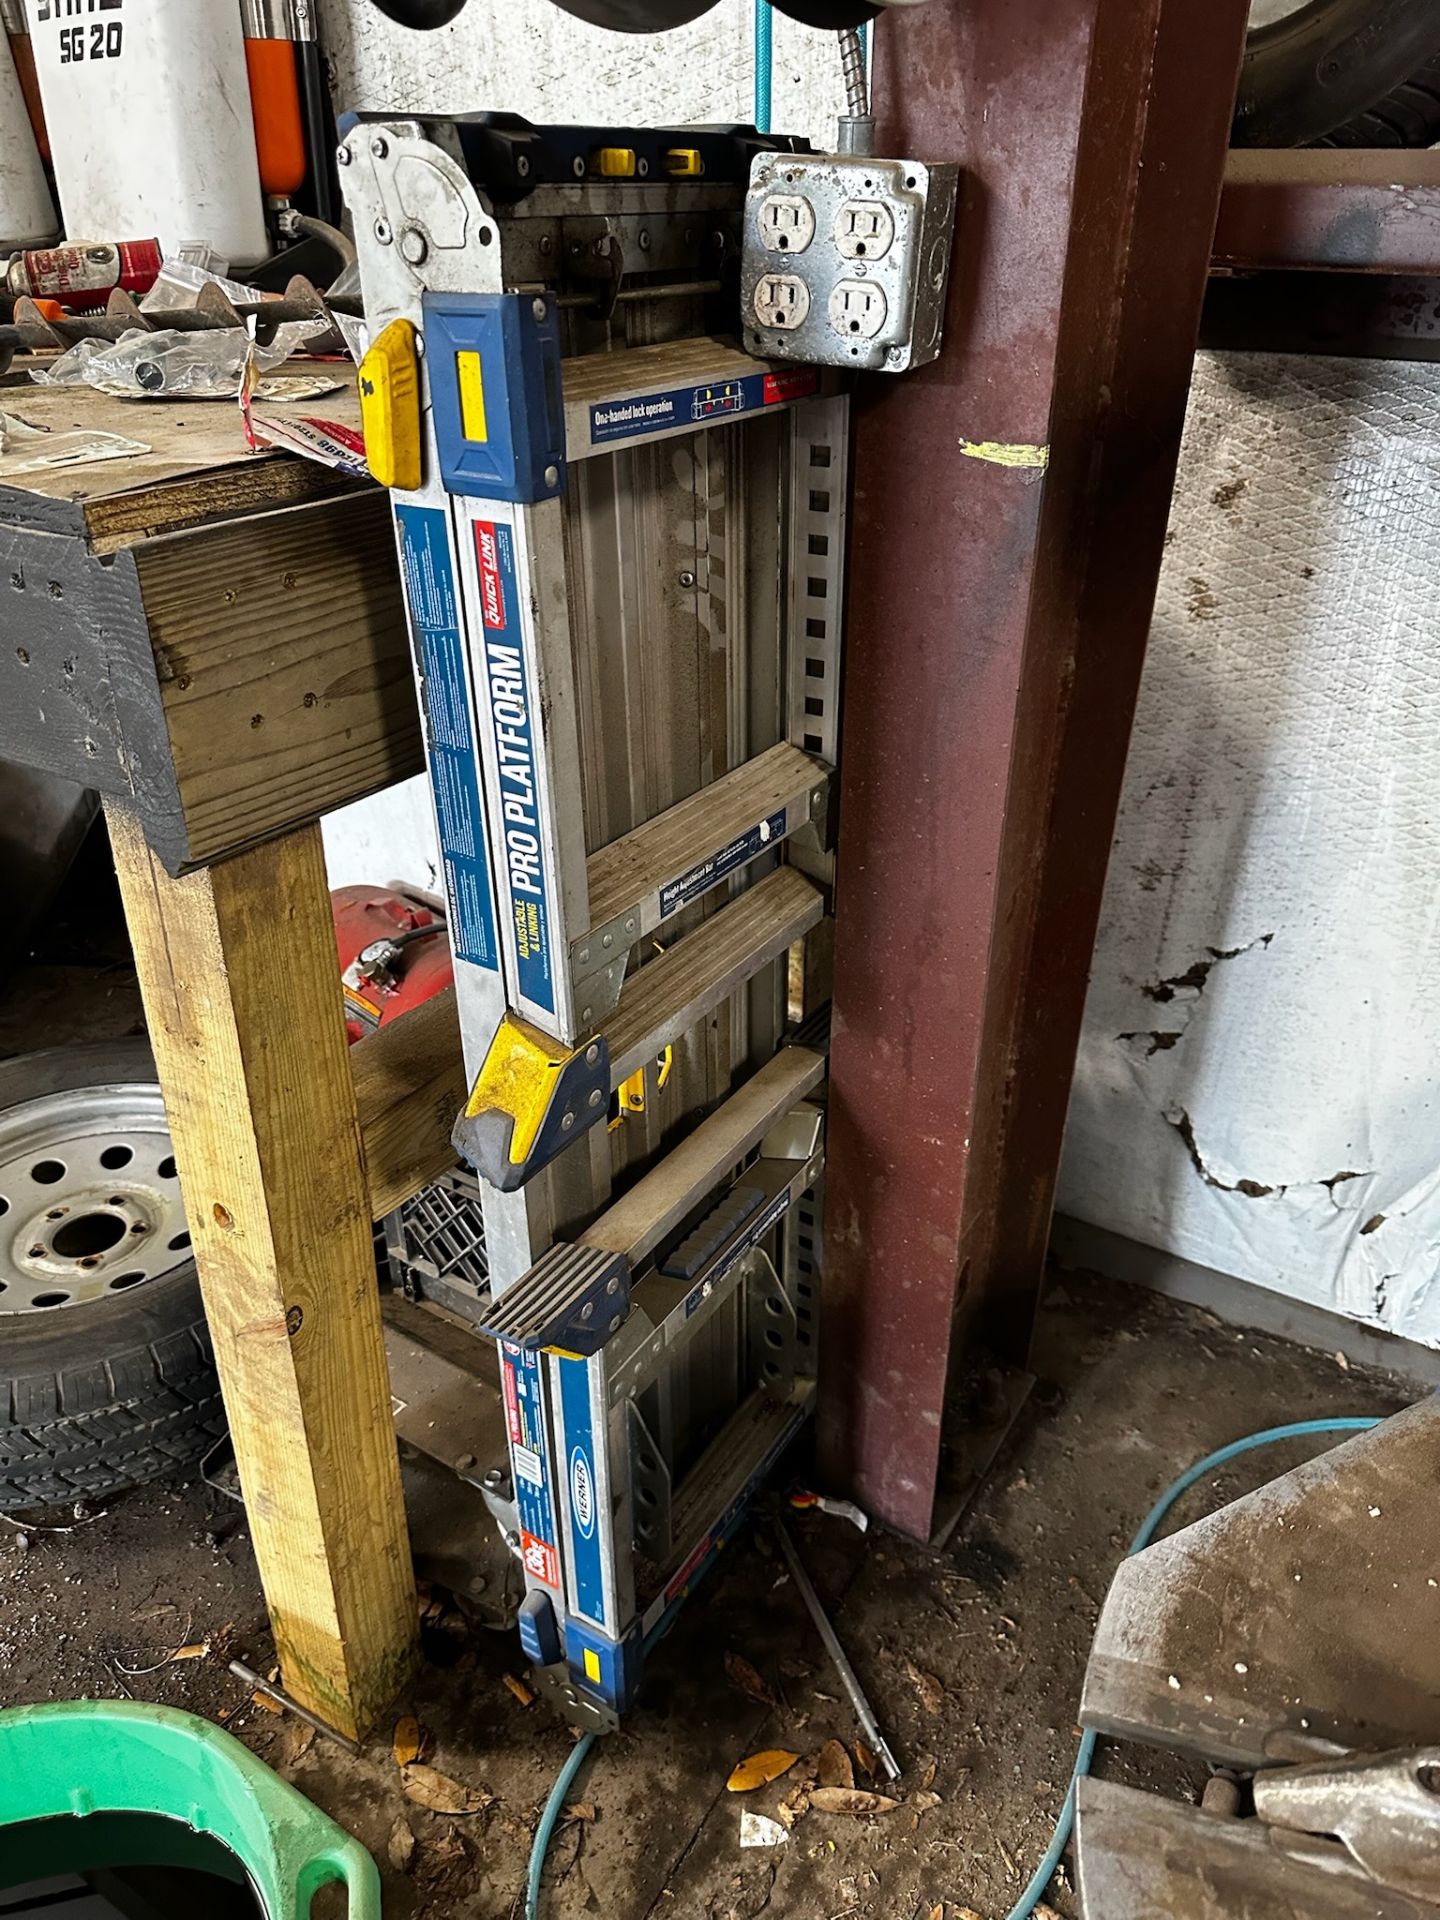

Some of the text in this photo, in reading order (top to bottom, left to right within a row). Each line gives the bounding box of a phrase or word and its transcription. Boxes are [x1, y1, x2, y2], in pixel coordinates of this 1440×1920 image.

[60, 21, 123, 64] SG 20
[595, 405, 633, 426] One-handed
[632, 403, 646, 419] lock
[645, 400, 673, 418] operation
[479, 529, 501, 626] QUICK LINK
[487, 642, 542, 896] PRO PLATFORM
[514, 898, 531, 960] ADJUSTABLE
[526, 902, 541, 952] & LINKING
[576, 1464, 589, 1520] WERNER
